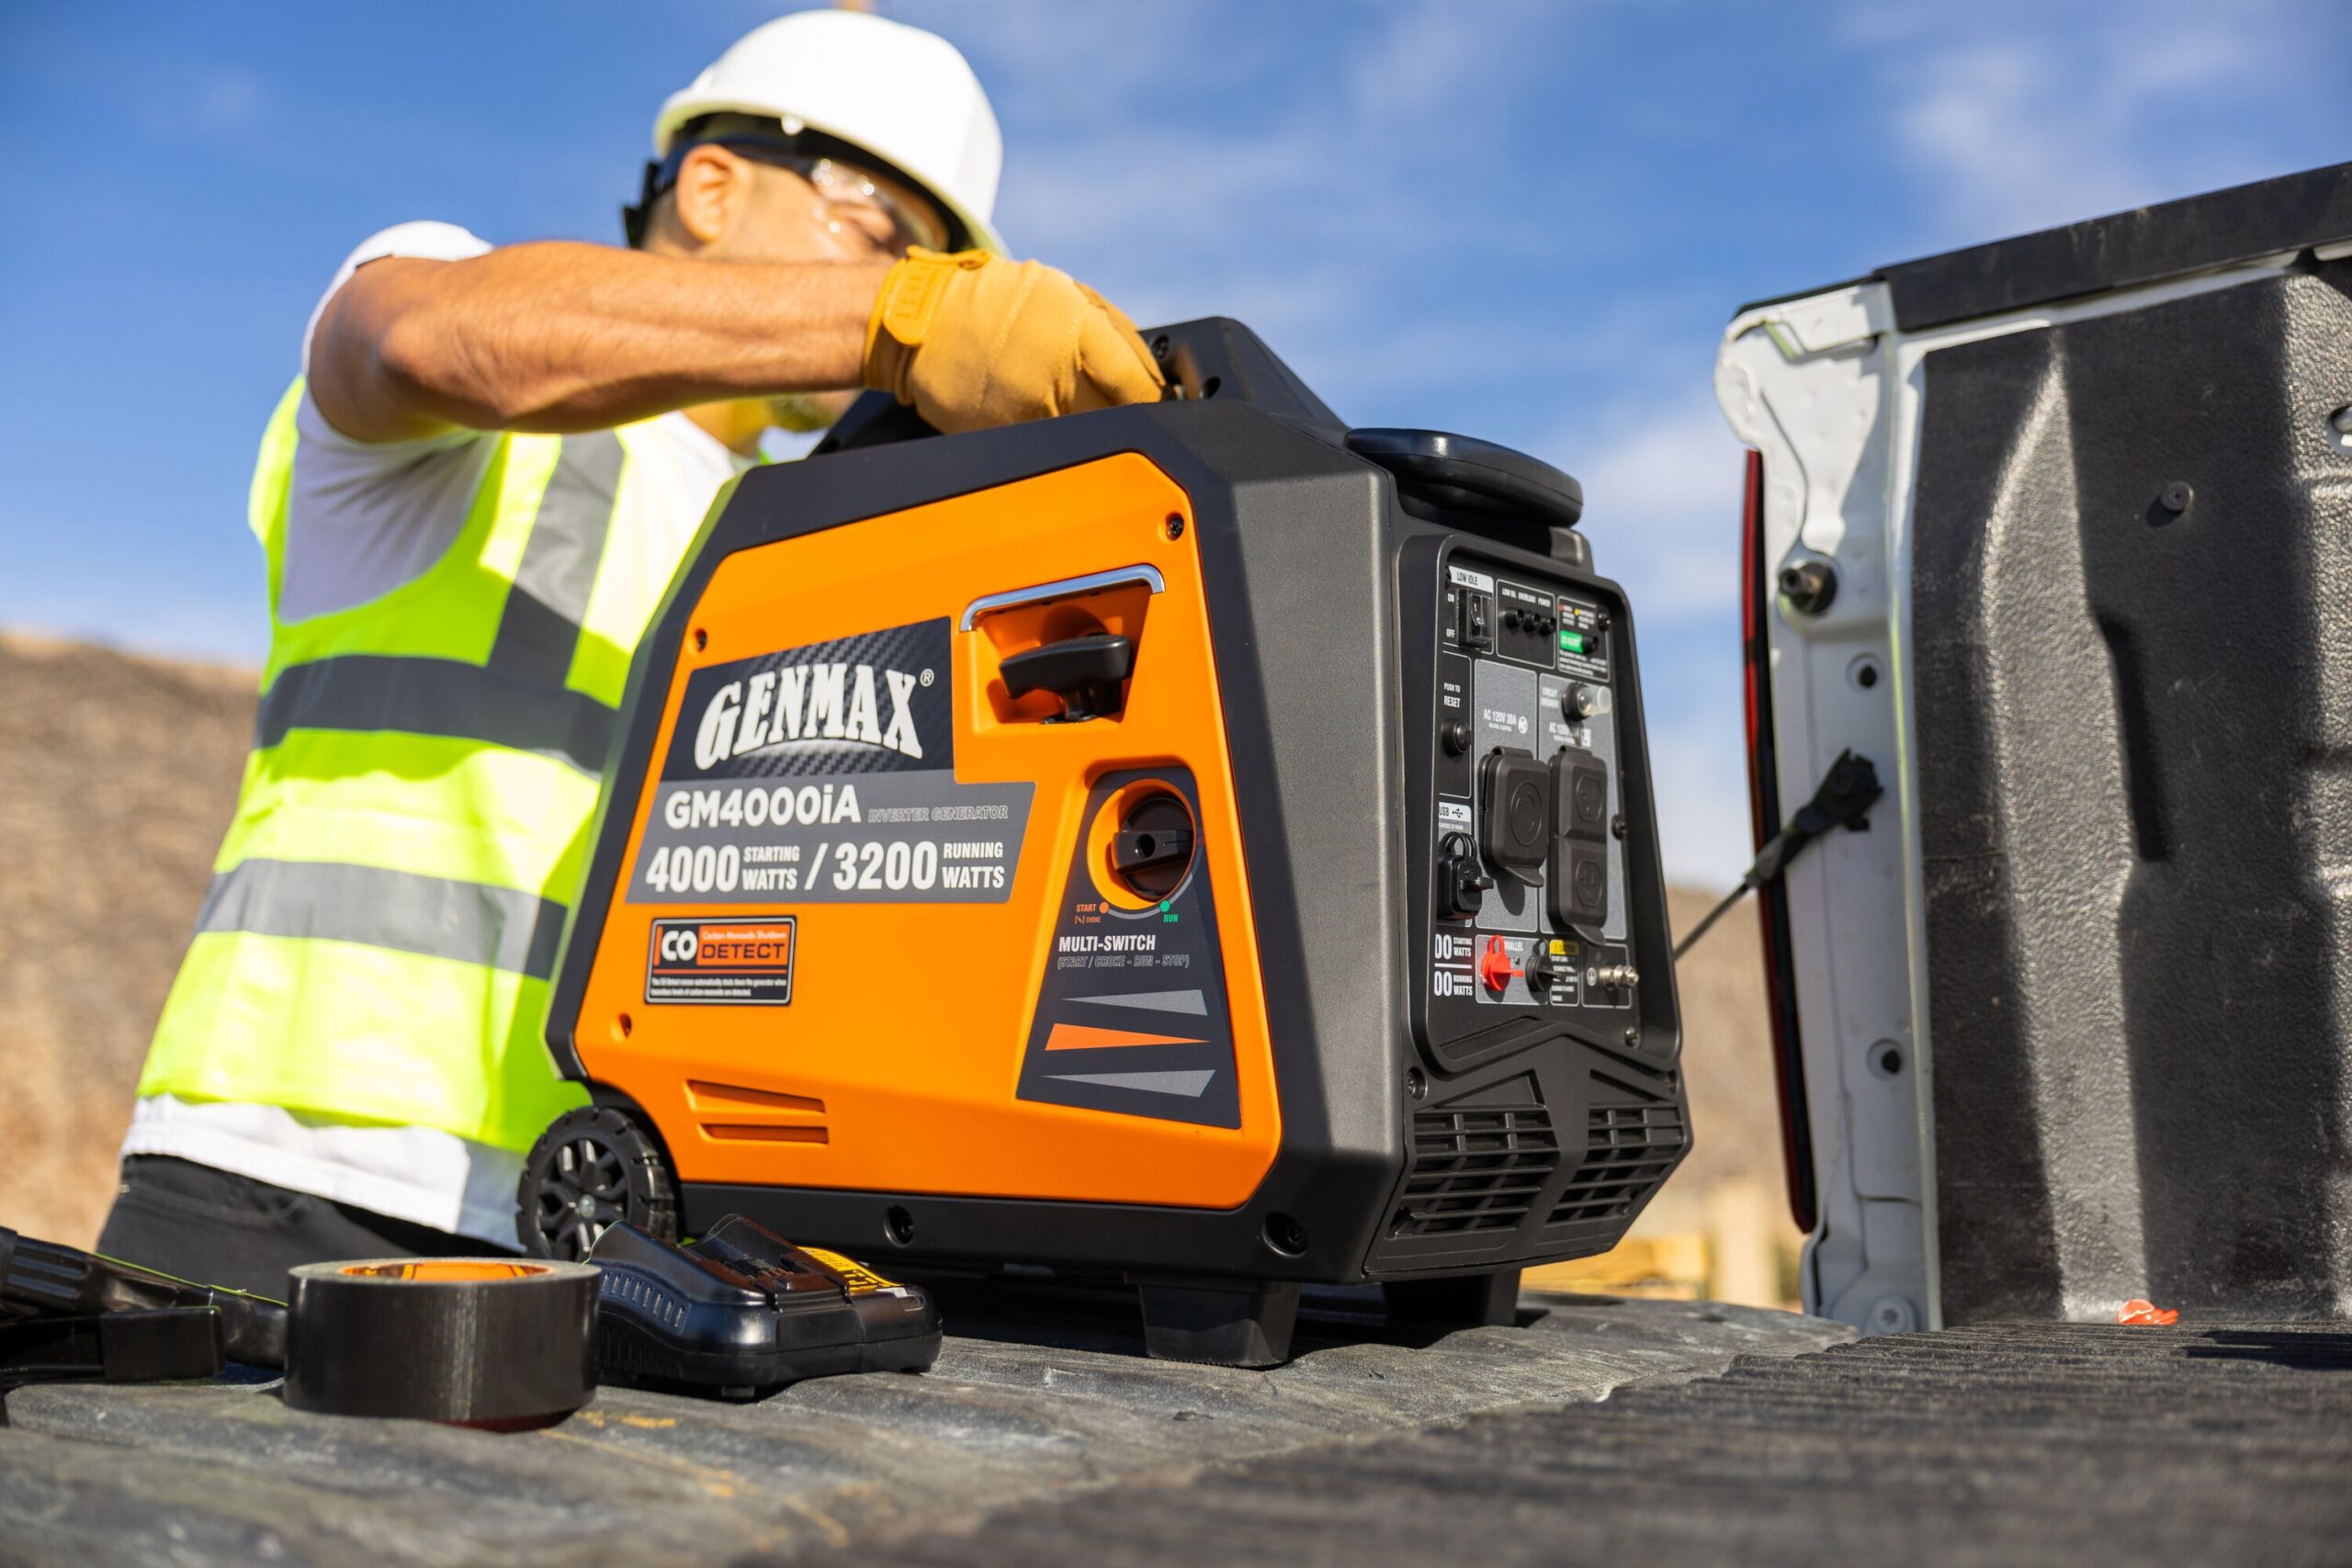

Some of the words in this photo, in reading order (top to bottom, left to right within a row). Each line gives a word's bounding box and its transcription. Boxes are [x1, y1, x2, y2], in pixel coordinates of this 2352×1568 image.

[1457, 571, 1467, 582] LOW
[1447, 593, 1454, 603] ON
[1446, 628, 1455, 637] OFF
[1444, 694, 1461, 708] RESET
[694, 662, 923, 770] GENMAX
[1483, 709, 1492, 720] AC
[1492, 710, 1506, 724] 120V
[664, 784, 861, 829] GM4000iA
[868, 807, 930, 823] INVERTER
[932, 806, 1009, 822] GENERATOR
[743, 846, 800, 863] STARTING
[943, 841, 1003, 859] RUNNING
[645, 845, 741, 893] 4000
[832, 840, 937, 890] 3200
[742, 868, 797, 890] WATTS
[942, 865, 1005, 889] WATTS
[1076, 904, 1097, 913] START
[1163, 914, 1179, 922] RUN
[661, 930, 698, 961] CO
[1058, 935, 1156, 953] MULTI-SWITCH
[1453, 937, 1473, 946] STARTING
[702, 942, 785, 959] DETECT
[1453, 946, 1472, 957] WATTS
[1094, 955, 1125, 968] CHOKE
[1134, 954, 1154, 967] RUN
[1161, 953, 1190, 968] STOP)
[1453, 985, 1474, 996] WATTS
